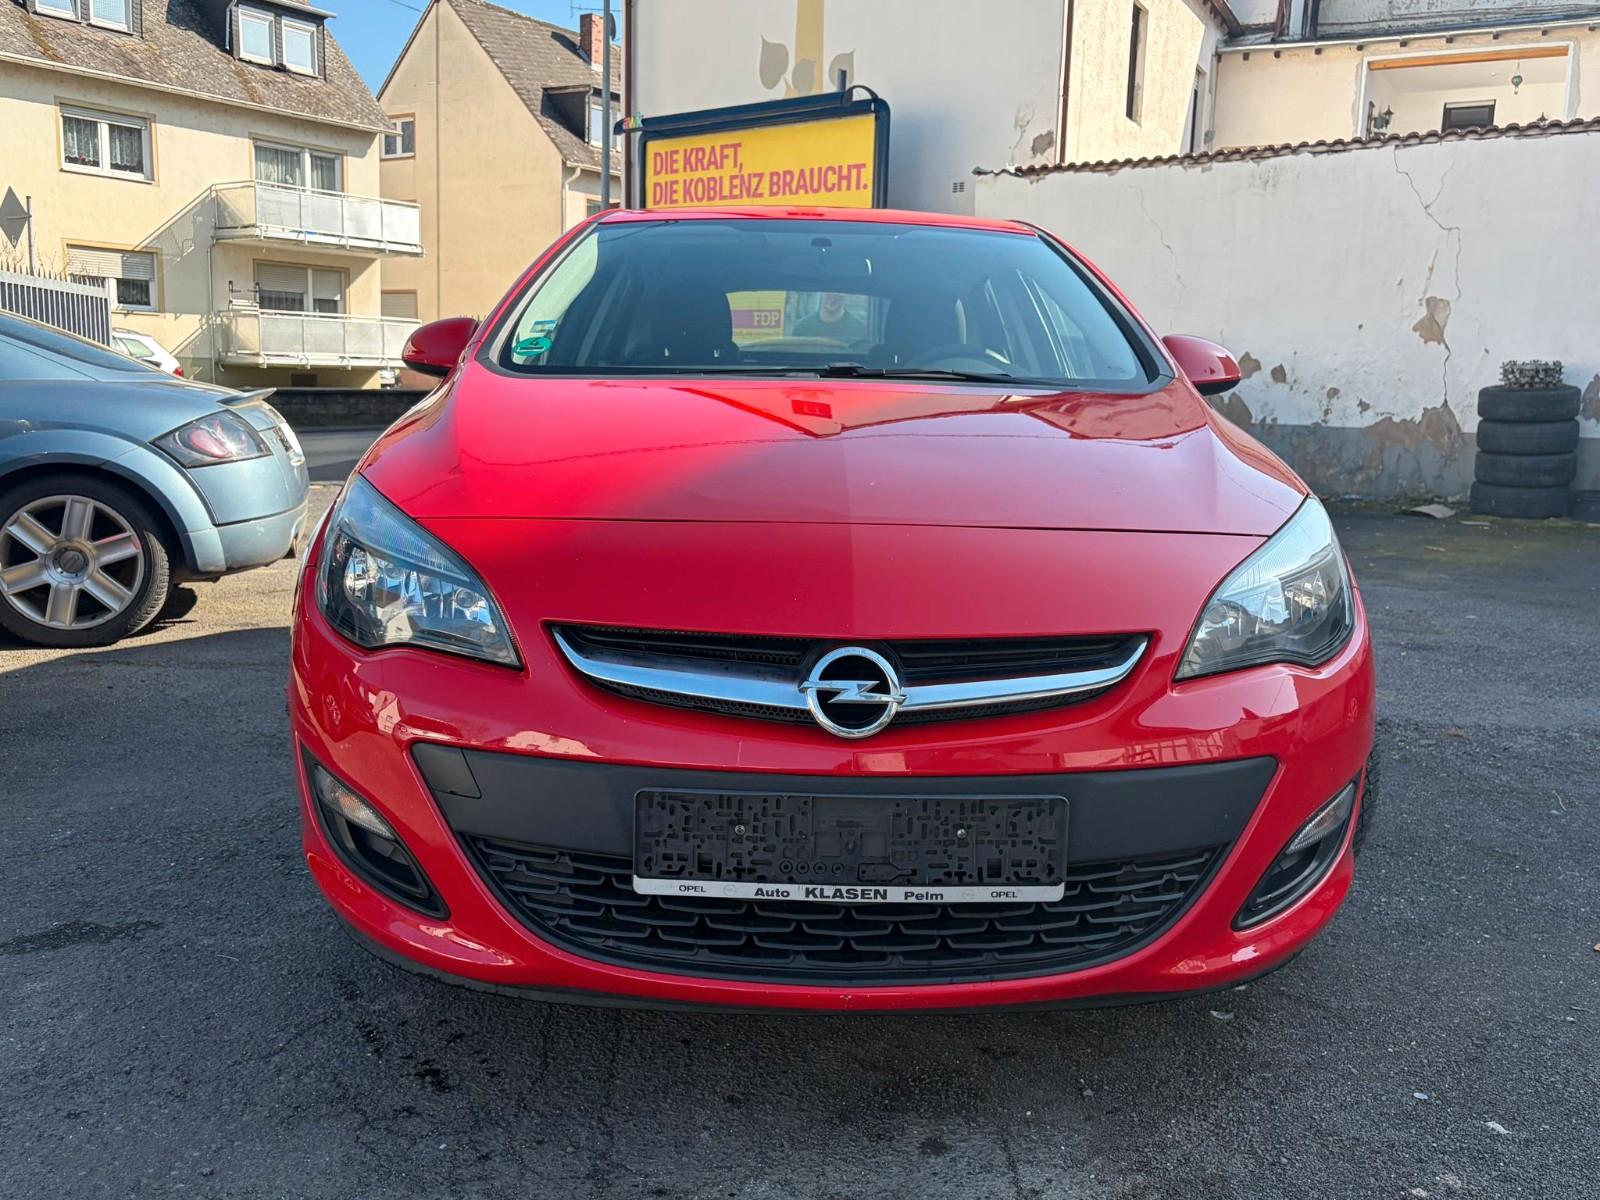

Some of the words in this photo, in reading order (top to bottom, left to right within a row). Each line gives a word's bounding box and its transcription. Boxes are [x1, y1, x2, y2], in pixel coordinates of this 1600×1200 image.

[653, 150, 679, 176] DIE
[683, 143, 743, 173] KRAFT,
[653, 179, 679, 206] DIE
[683, 172, 764, 202] KOBLENZ
[769, 163, 868, 197] BRAUCHT.
[753, 311, 780, 326] FDP
[678, 884, 706, 893] OPEL
[754, 887, 790, 898] Auto
[804, 887, 888, 900] KLASEN
[904, 890, 944, 901] Pelm
[990, 890, 1018, 899] OPEL
